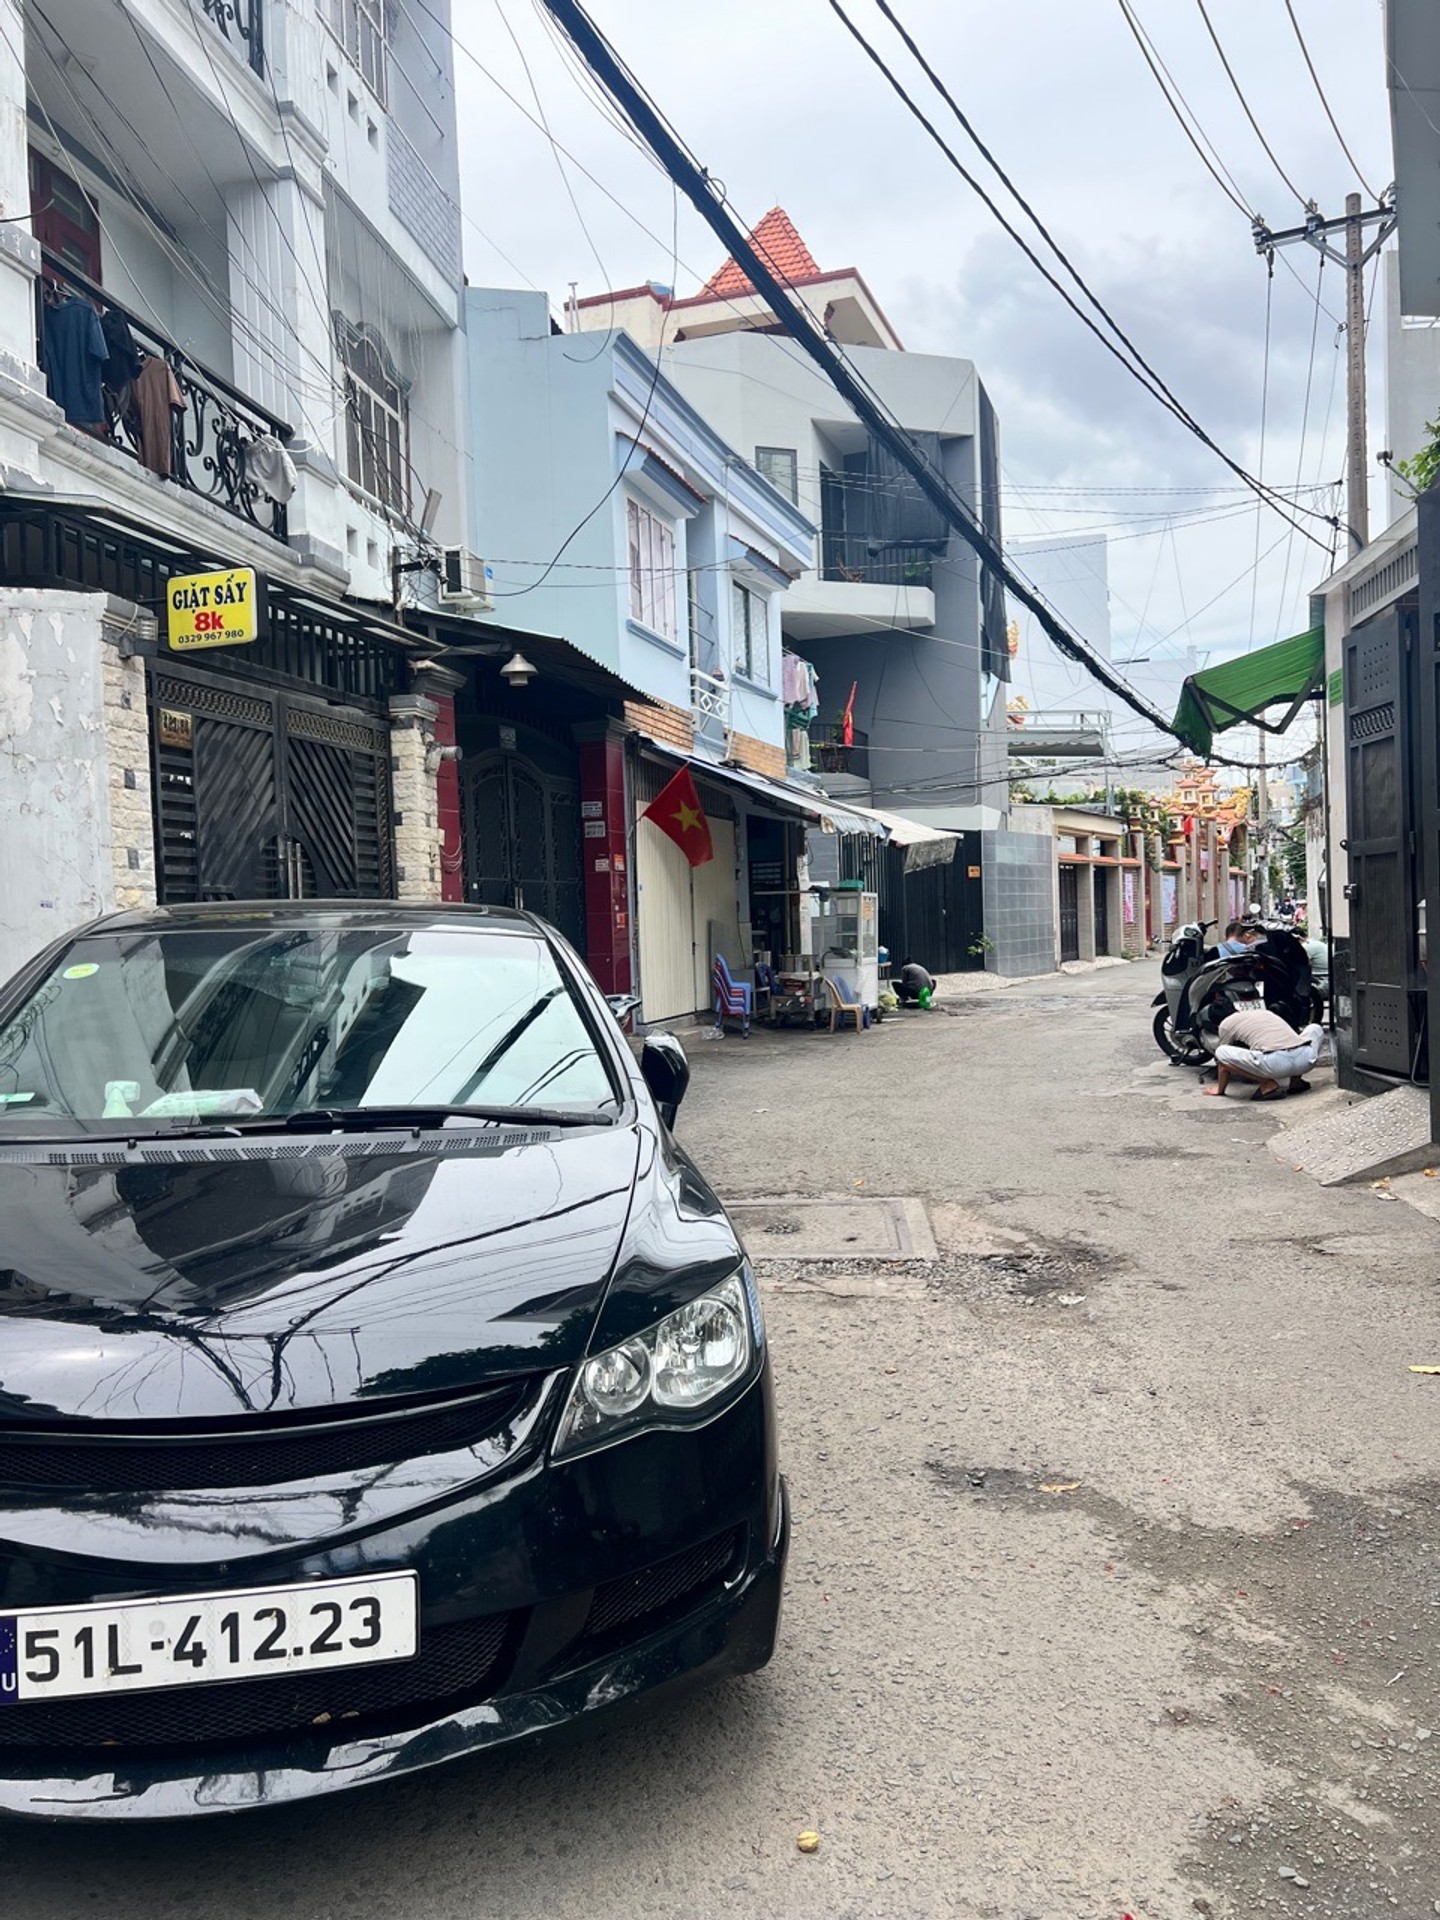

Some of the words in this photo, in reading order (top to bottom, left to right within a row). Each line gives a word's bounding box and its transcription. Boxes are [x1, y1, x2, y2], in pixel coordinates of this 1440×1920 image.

[172, 582, 210, 614] GIẶT
[214, 574, 247, 605] SẤY
[194, 610, 225, 632] 8k
[178, 634, 202, 644] 0329
[204, 631, 222, 641] 967
[225, 629, 245, 639] 980
[25, 1597, 382, 1683] 51L-412.23
[2, 1672, 16, 1691] U
